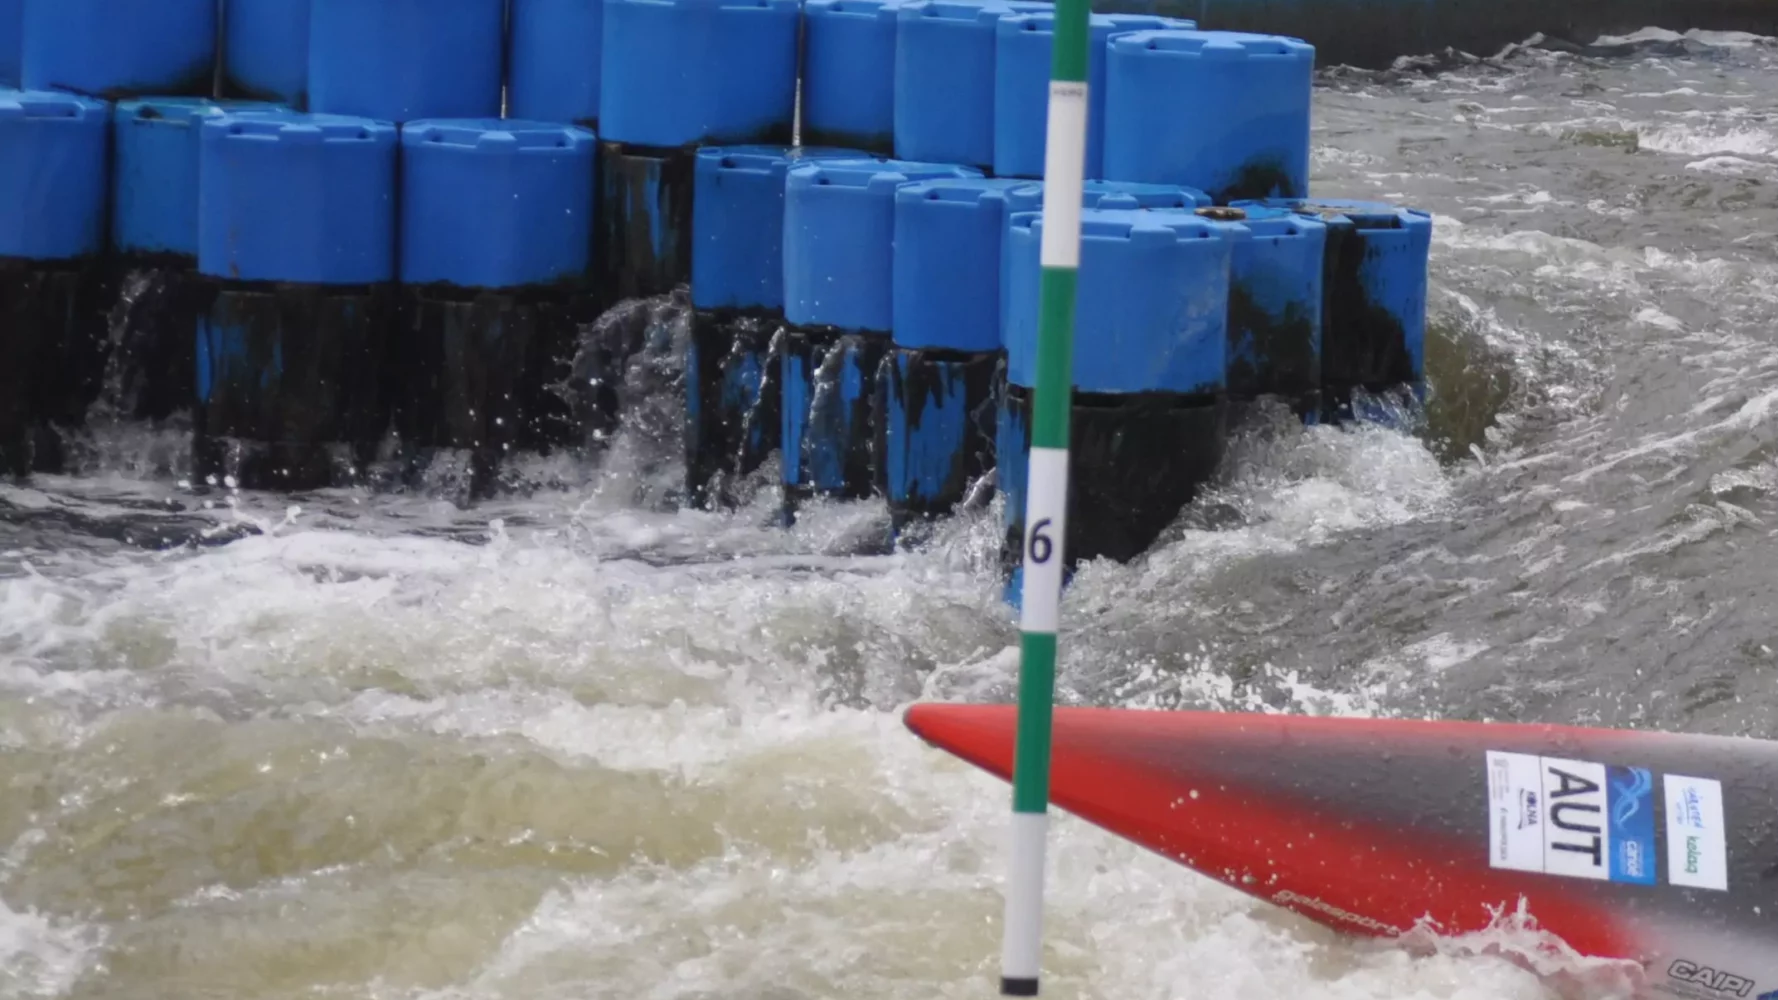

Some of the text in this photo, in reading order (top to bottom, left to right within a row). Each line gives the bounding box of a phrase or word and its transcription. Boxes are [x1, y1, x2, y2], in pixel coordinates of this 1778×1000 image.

[1028, 517, 1052, 564] 6
[1547, 766, 1602, 867] AUT
[1684, 835, 1699, 875] kelag
[1667, 958, 1755, 998] CAIPI
